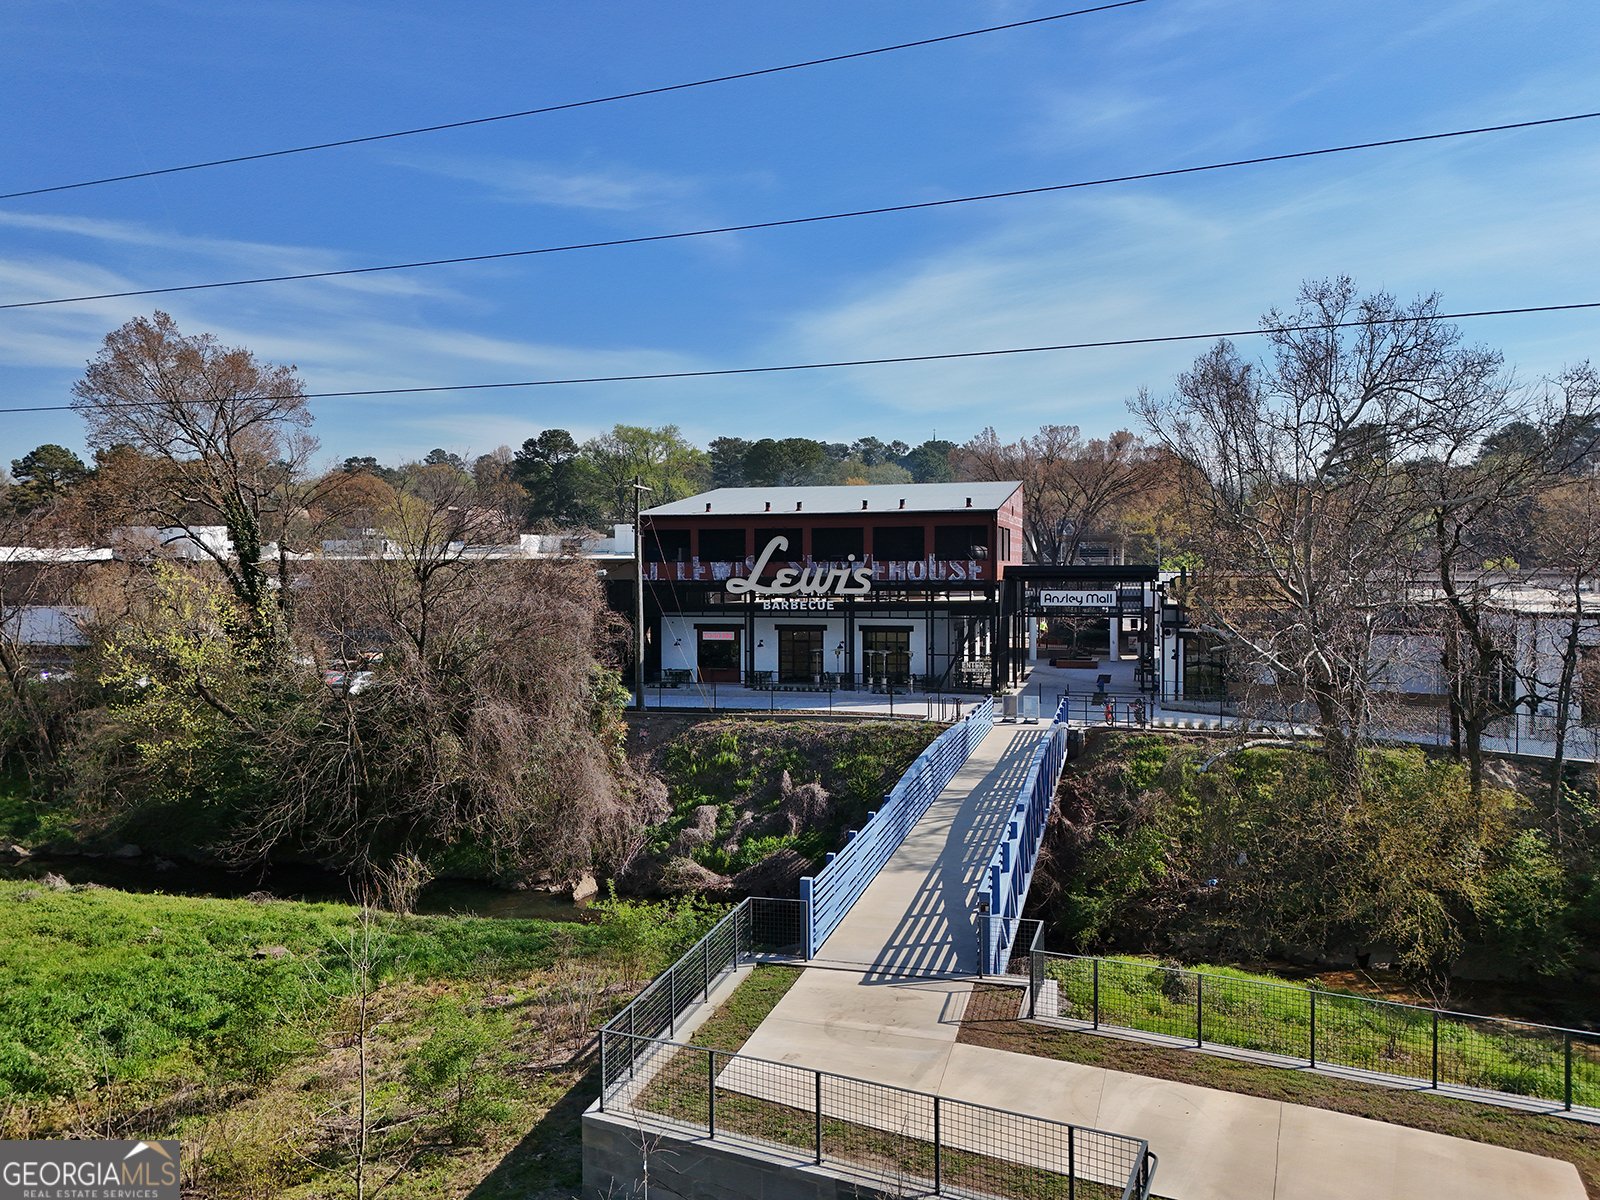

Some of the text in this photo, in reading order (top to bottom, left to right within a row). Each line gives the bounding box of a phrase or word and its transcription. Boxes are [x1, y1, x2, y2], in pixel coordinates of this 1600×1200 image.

[726, 535, 872, 594] Lewis
[1044, 593, 1113, 605] Ansley Mall
[763, 601, 834, 610] BARBECUE
